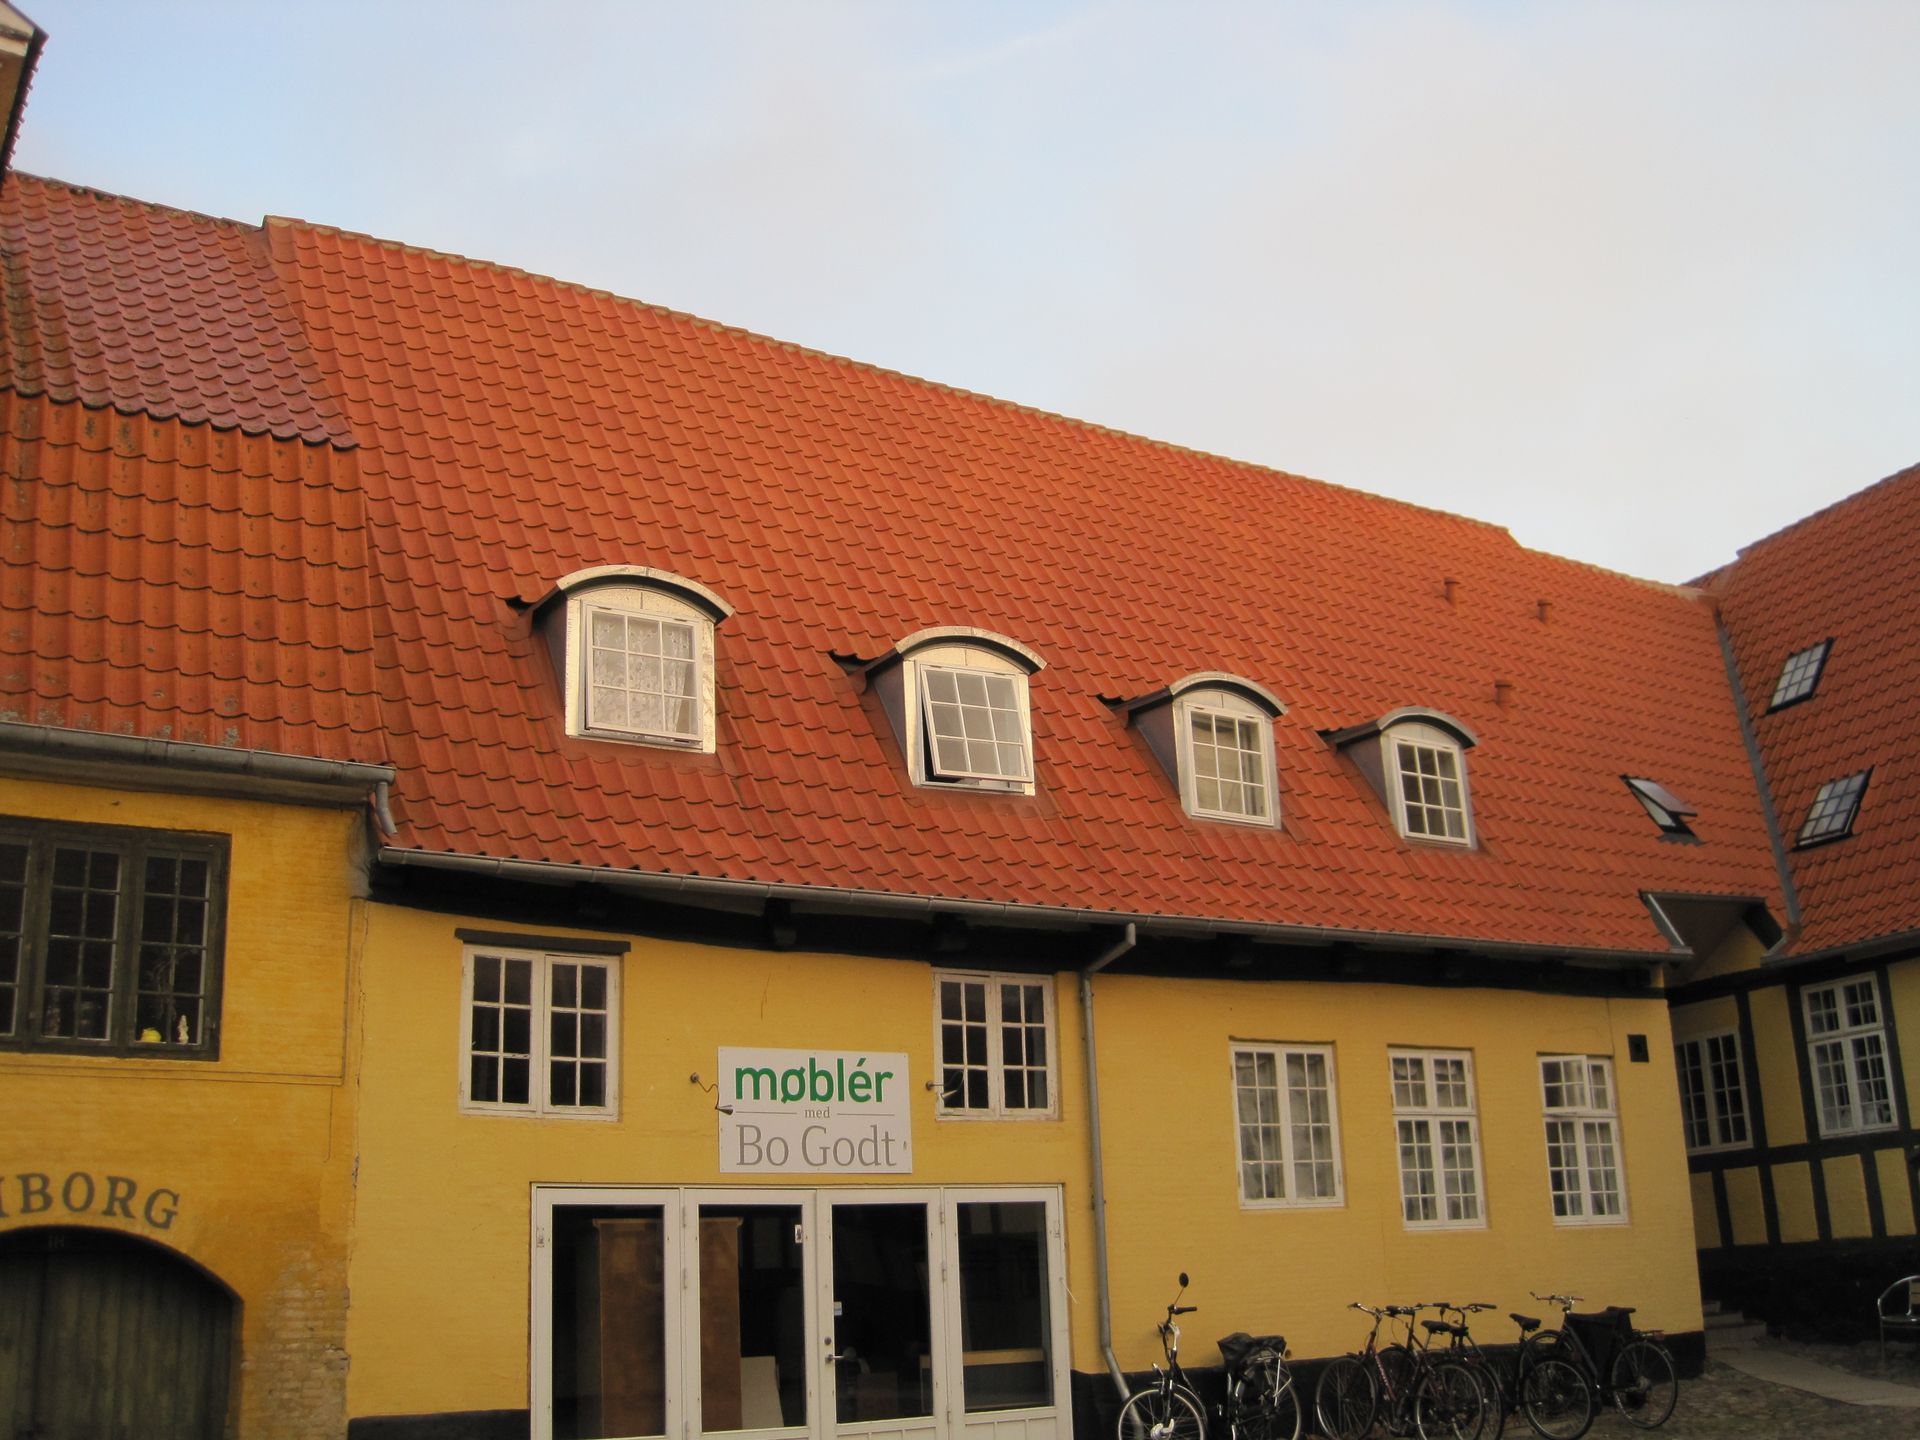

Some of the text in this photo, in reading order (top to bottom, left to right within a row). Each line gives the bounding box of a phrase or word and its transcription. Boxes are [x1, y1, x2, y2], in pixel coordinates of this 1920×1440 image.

[735, 1057, 894, 1104] møblér
[804, 1107, 830, 1119] med
[736, 1124, 897, 1167] Bo Godt
